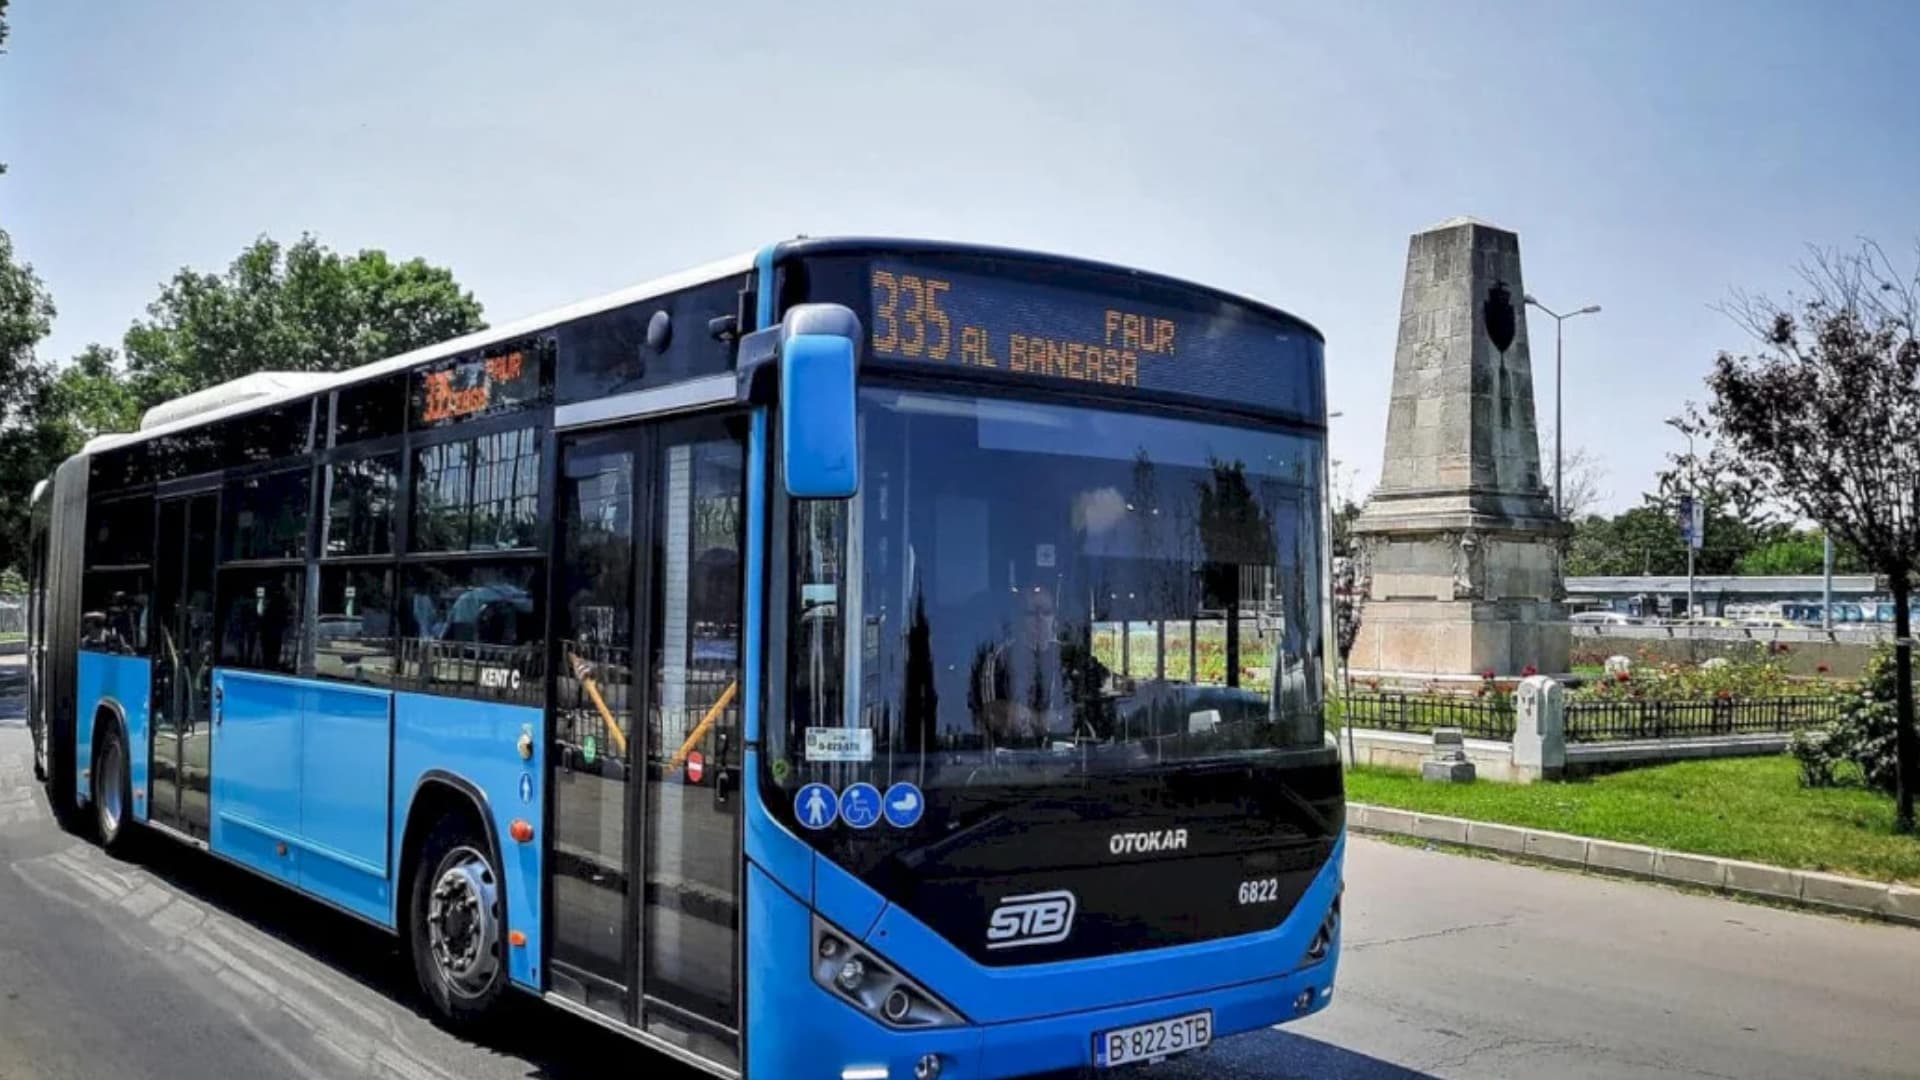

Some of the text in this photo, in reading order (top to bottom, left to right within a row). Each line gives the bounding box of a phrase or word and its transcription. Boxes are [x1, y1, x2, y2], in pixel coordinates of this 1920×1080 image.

[872, 271, 950, 360] 335
[1105, 310, 1176, 356] FAUR
[961, 326, 1138, 387] AL BANEASA
[480, 667, 521, 690] KENT C
[1109, 828, 1188, 854] OTOKAR
[1238, 878, 1278, 904] 6822
[986, 899, 1068, 940] STB
[1109, 1017, 1209, 1062] B 822 STB
